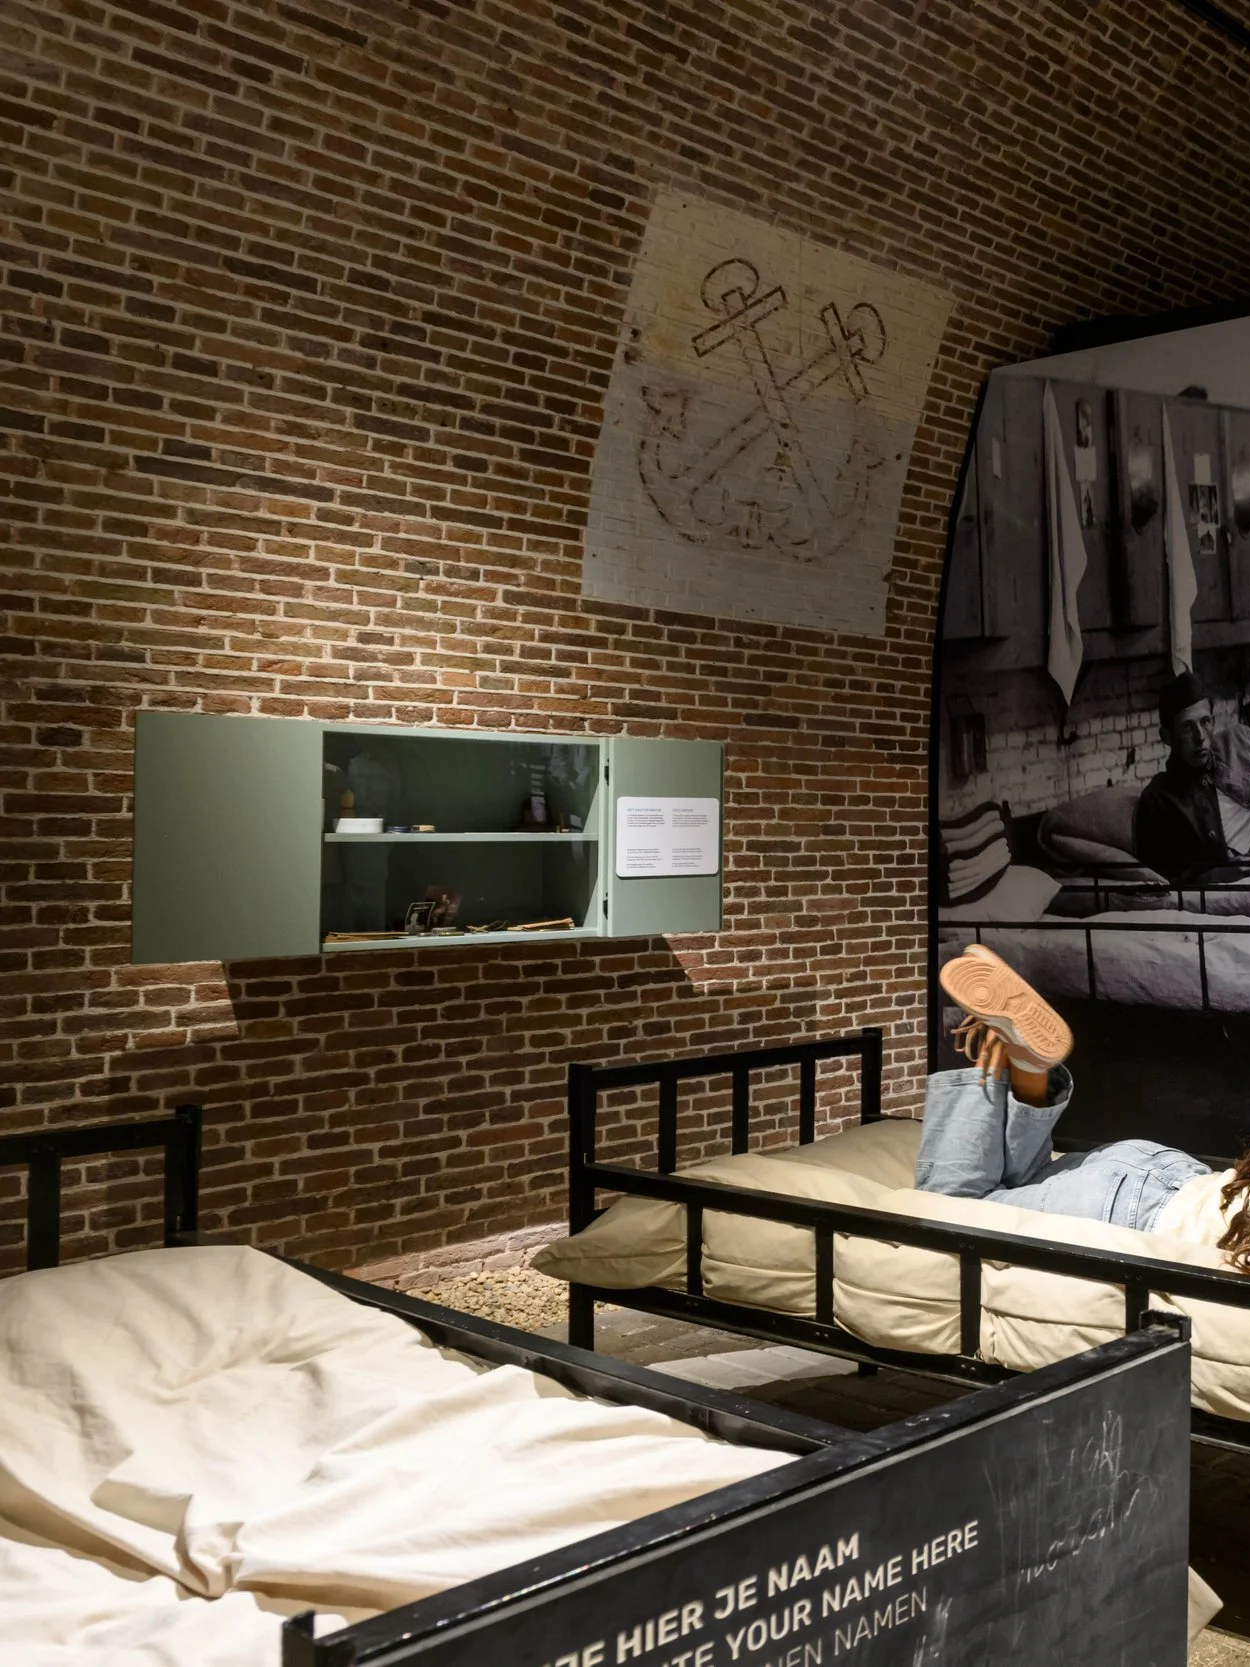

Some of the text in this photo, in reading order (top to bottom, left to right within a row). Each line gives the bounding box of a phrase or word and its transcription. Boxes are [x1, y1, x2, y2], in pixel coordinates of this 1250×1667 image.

[616, 1600, 705, 1664] HIER
[714, 1574, 757, 1620] JE
[768, 1531, 860, 1598] NAAM
[726, 1598, 812, 1660] YOUR
[822, 1555, 903, 1618] NAME
[912, 1520, 979, 1575] HERE
[834, 1586, 927, 1656] NAMEN
